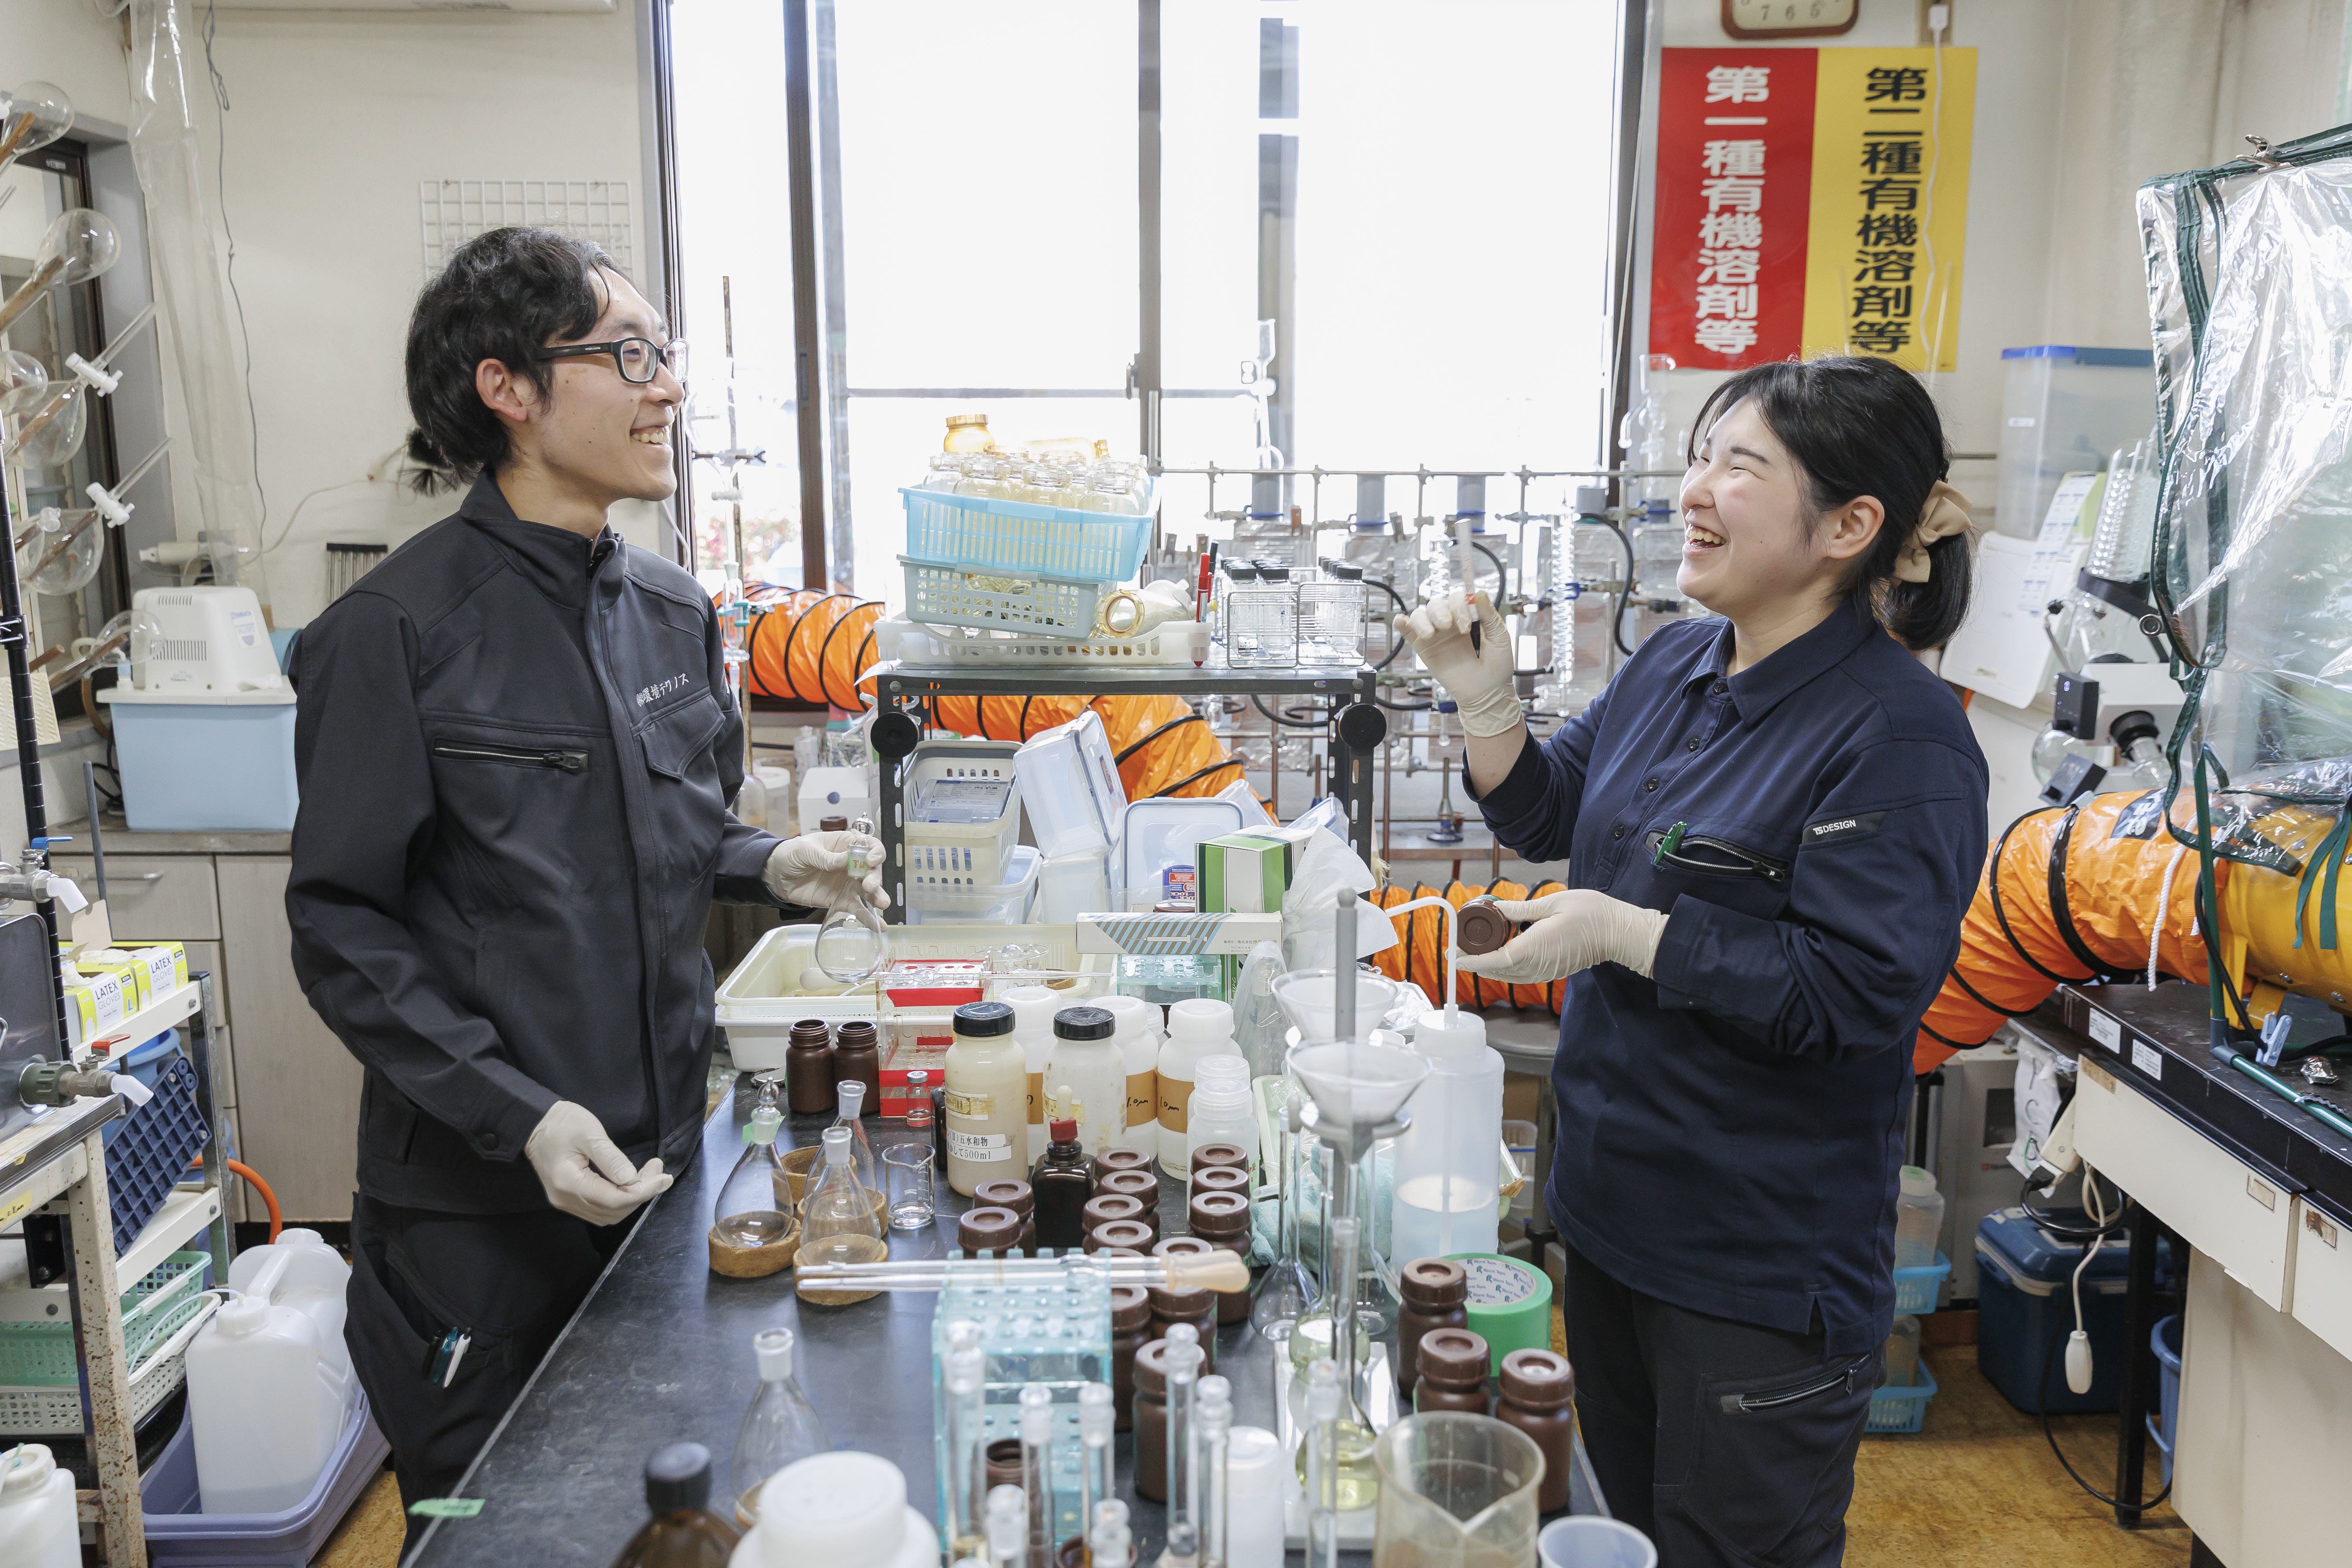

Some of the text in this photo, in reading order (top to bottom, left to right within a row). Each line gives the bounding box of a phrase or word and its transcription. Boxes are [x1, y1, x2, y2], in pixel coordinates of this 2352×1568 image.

[1695, 66, 1771, 354] 第一種有機溶剤等
[1850, 67, 1927, 353] 第二種有機溶剤等
[151, 956, 172, 974] LATEX
[153, 967, 174, 983] GLOVES
[180, 972, 185, 985] S
[95, 980, 119, 1000] LATEX
[98, 992, 121, 1010] GLOVES
[128, 999, 133, 1011] L
